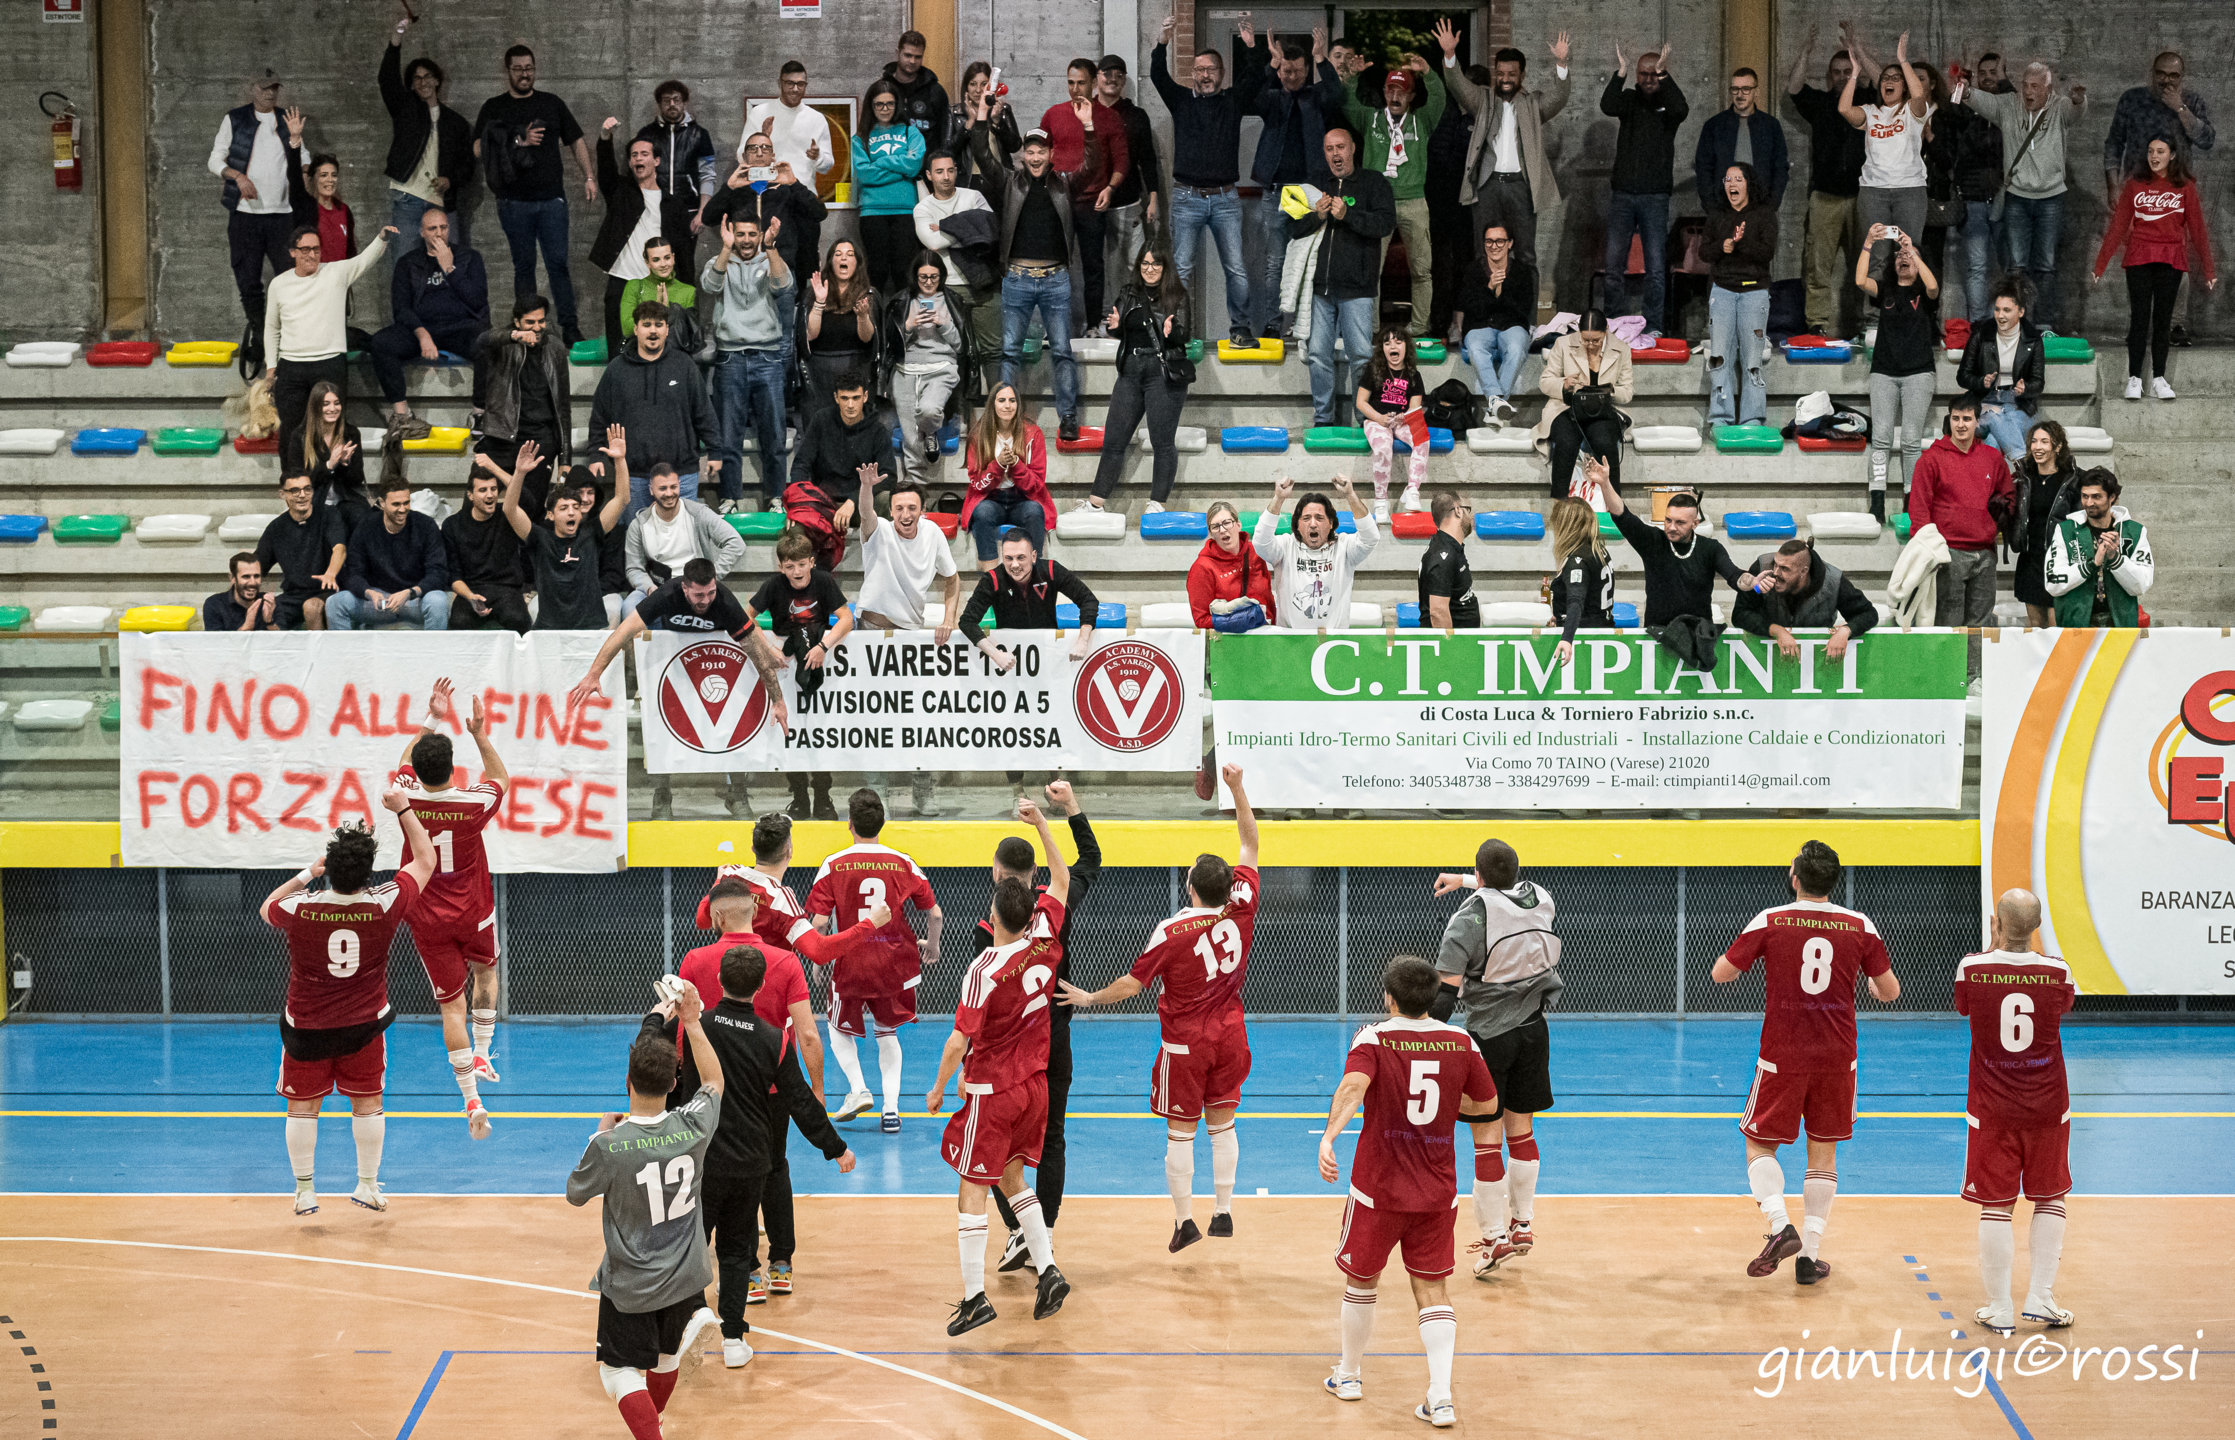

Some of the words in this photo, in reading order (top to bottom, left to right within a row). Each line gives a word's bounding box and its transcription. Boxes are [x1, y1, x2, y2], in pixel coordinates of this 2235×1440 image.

[1870, 125, 1904, 138] EURO
[2136, 550, 2152, 565] 24
[669, 614, 715, 630] GCDS
[683, 649, 702, 665] A.S.
[703, 648, 744, 665] VARESE
[870, 643, 970, 678] VARESE
[1105, 647, 1158, 662] ACADEMY
[700, 660, 726, 671] 1910
[1119, 668, 1138, 677] 1910
[1120, 658, 1153, 671] VARESE
[1310, 639, 1452, 697] C.T.
[1477, 638, 1864, 697] IMPIANTI
[138, 664, 310, 742] FINO
[481, 685, 613, 751] FINE
[797, 689, 917, 715] DIVISIONE
[922, 689, 1007, 714] CALCIO
[1014, 690, 1031, 714] A
[1036, 689, 1051, 714] 5
[1420, 706, 1435, 721] di
[1441, 706, 1488, 721] Costa
[1494, 706, 1535, 721] Luca
[1541, 707, 1557, 721] &
[1561, 706, 1633, 721] Torniero
[1639, 705, 1708, 721] Fabrizio
[1713, 707, 1754, 720] s.n.c.
[785, 726, 895, 750] PASSIONE
[901, 726, 1062, 750] BIANCOROSSA
[1116, 739, 1145, 749] A.S.D.
[1227, 731, 1293, 749] Impianti
[1299, 731, 1390, 747] Idro-Termo
[1396, 731, 1457, 747] Sanitari
[1463, 731, 1507, 746] Civili
[1513, 731, 1532, 746] ed
[1537, 731, 1618, 746] Industriali
[1642, 730, 1743, 746] Installazione
[1748, 730, 1809, 745] Caldaie
[1814, 734, 1823, 745] e
[1828, 729, 1946, 745] Condizionatori
[1465, 757, 1488, 770] Via
[1492, 757, 1532, 770] Como
[1536, 757, 1552, 770] 70
[1556, 757, 1606, 770] TAINO
[1610, 756, 1665, 771] (Varese)
[1669, 756, 1710, 770] 21020
[1342, 775, 1405, 788] Telefono:
[1409, 775, 1491, 788] 3405348738
[1507, 774, 1590, 788] 3384297699
[1611, 774, 1659, 788] E-mail:
[1663, 773, 1831, 790] ctimpianti14@gmail.com
[136, 767, 376, 834] FORZA
[2168, 756, 2235, 846] E
[426, 830, 454, 873] 1
[853, 861, 898, 872] IMPIANTI
[858, 877, 887, 922] 3
[300, 910, 319, 922] C.T.
[319, 911, 373, 922] IMPIANTI
[1774, 915, 1795, 927] C.T.
[1796, 916, 1850, 931] IMPIANTI
[327, 928, 360, 978] 9
[1193, 918, 1243, 983] 13
[1800, 936, 1834, 995] 8
[1970, 973, 1992, 984] C.T.
[1993, 973, 2051, 985] IMPIANTI
[1021, 964, 1053, 1019] 2
[714, 1015, 734, 1028] FUTSAL
[734, 1019, 754, 1031] VARESE
[2000, 992, 2035, 1053] 6
[1400, 1040, 1457, 1052] IMPIANTI
[1406, 1060, 1440, 1126] 5
[608, 1139, 633, 1153] C.T.
[636, 1130, 693, 1149] IMPIANTI
[636, 1154, 696, 1227] 12
